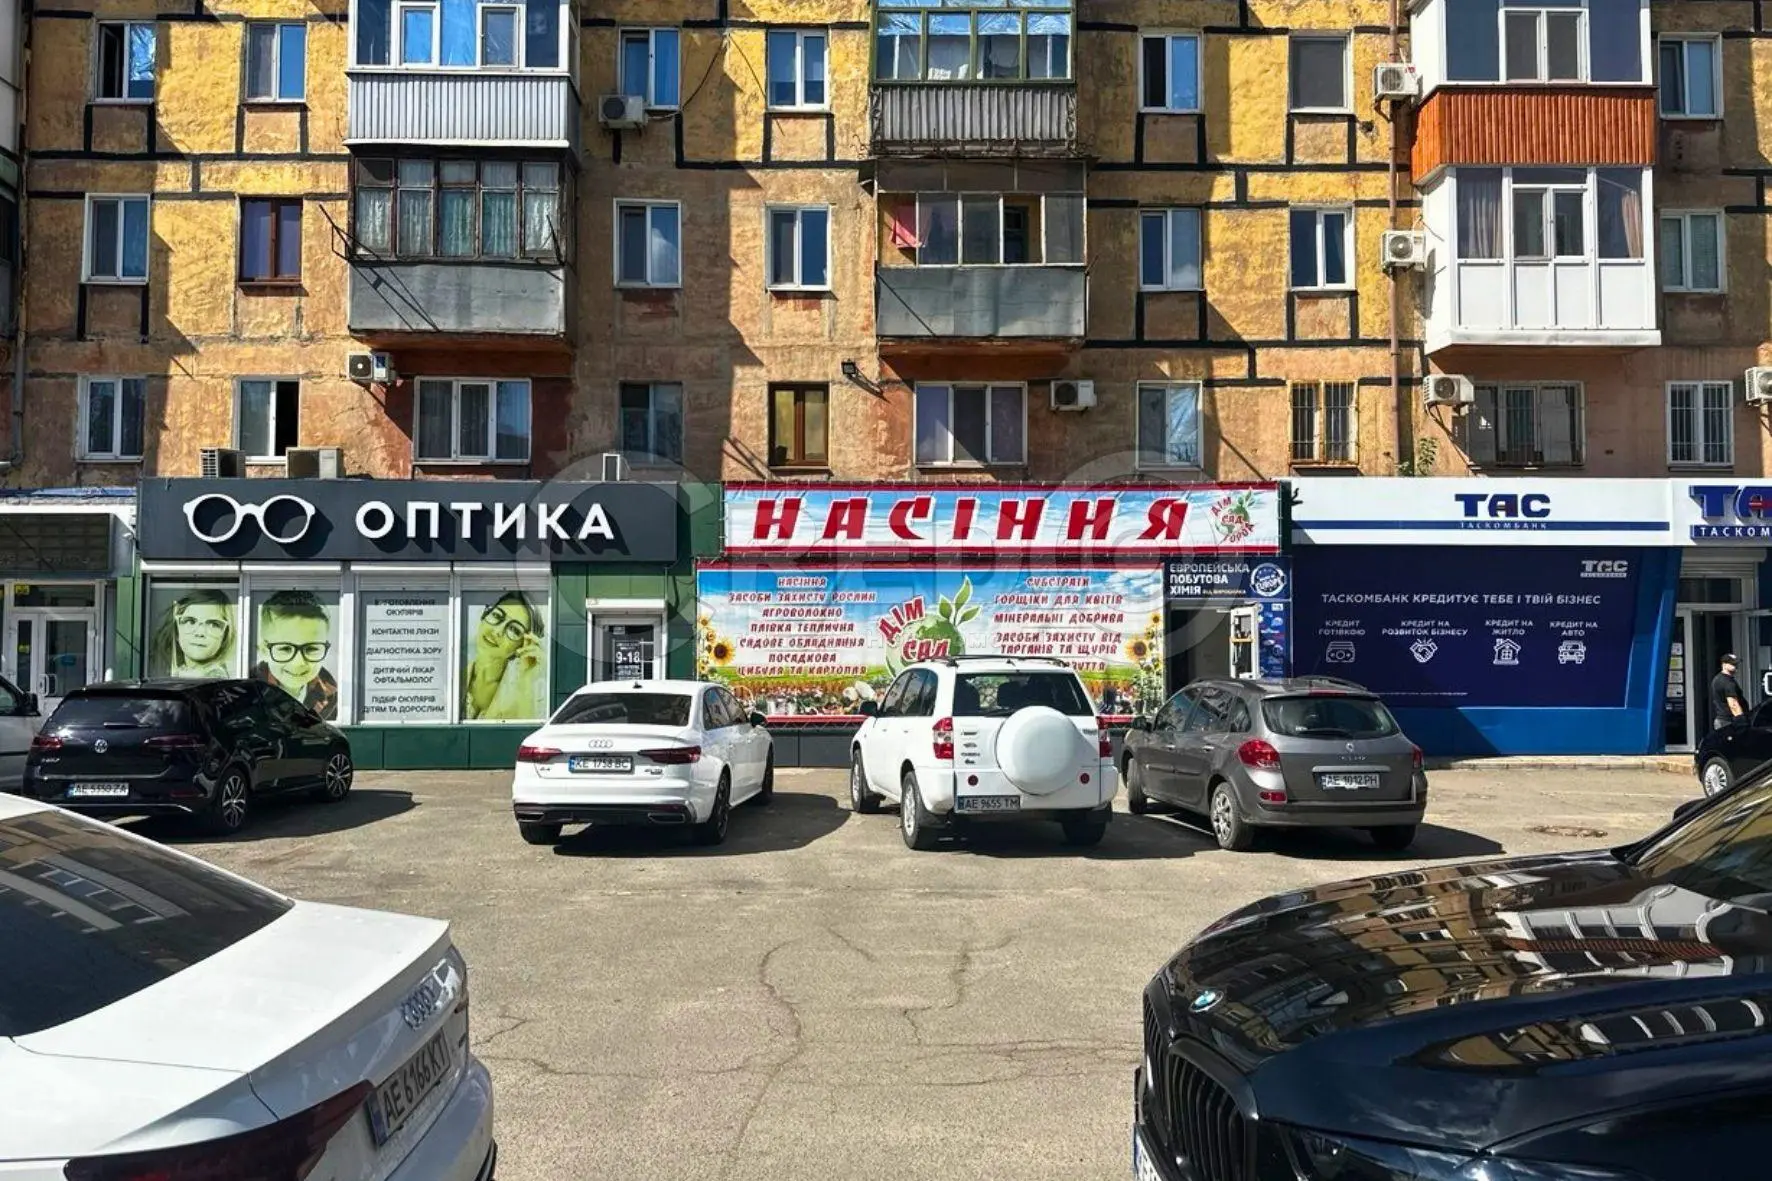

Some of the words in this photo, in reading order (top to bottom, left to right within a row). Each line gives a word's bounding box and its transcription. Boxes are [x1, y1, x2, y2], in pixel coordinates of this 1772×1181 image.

[1455, 494, 1551, 518] ТАС
[355, 501, 614, 539] ОПТИКА
[753, 497, 1190, 540] НАСІННЯ
[1461, 521, 1547, 530] ТАСКОМБАНК
[1169, 562, 1250, 573] ЄВРОПЕЙСЬКА
[778, 577, 826, 587] НАСІННЯ
[1169, 574, 1229, 584] ПОБУТОВА
[1169, 585, 1201, 596] ХІМІЯ
[728, 592, 772, 602] ЗАСОБИ
[778, 592, 826, 602] ЗАХИСТУ
[832, 592, 876, 602] РОСЛИН
[1054, 595, 1080, 606] ДЛЯ
[1085, 595, 1124, 605] КВІТІВ
[1321, 594, 1409, 604] ТАСКОМБАНК
[1413, 594, 1480, 605] КРЕДИТУЄ
[1483, 594, 1514, 604] ТЕБЕ
[1524, 593, 1554, 604] ТВІЙ
[1556, 594, 1601, 605] БІЗНЕС
[762, 607, 843, 618] АГРОВОЛОКНО
[879, 596, 924, 645] ДІМ
[993, 613, 1064, 623] МІНЕРАЛЬНІ
[1068, 613, 1124, 625] ДОБРИВА
[1325, 620, 1360, 628] КРЕДИТ
[1401, 620, 1436, 628] КРЕДИТ
[1484, 620, 1520, 628] КРЕДИТ
[750, 623, 792, 632] ПЛІВКА
[797, 623, 854, 632] ТЕПЛИЧНА
[1549, 621, 1584, 629] КРЕДИТ
[1585, 621, 1598, 629] НА
[371, 628, 415, 636] КОНТАКТНІ
[1381, 628, 1429, 636] РОЗВИТОК
[1431, 628, 1468, 636] БІЗНЕСУ
[1492, 628, 1525, 636] ЖИТЛО
[1561, 629, 1585, 637] АВТО
[739, 637, 784, 649] САДОВЕ
[788, 637, 865, 649] ОБЛАДНАННЯ
[996, 632, 1040, 643] ЗАСОБИ
[1045, 632, 1096, 643] ЗАХИСТУ
[1101, 632, 1122, 644] ВІД
[366, 647, 421, 655] ДІАГНОСТИКА
[1000, 644, 1054, 654] ТАРГАНІВ
[1060, 644, 1073, 654] ТА
[1077, 644, 1118, 655] ЩУРІВ
[615, 652, 640, 664] 9-18
[768, 653, 837, 664] ПОСАДКОВА
[737, 666, 784, 676] ЦИБУЛЯ
[790, 666, 805, 675] ТА
[808, 666, 868, 675] КАРТОПЛЯ
[1066, 661, 1106, 671] ЗУТТЯ
[389, 705, 398, 713] ТА
[966, 798, 979, 809] AE
[1005, 798, 1019, 809] TM
[382, 1080, 406, 1129] AE
[426, 1033, 446, 1076] KT
